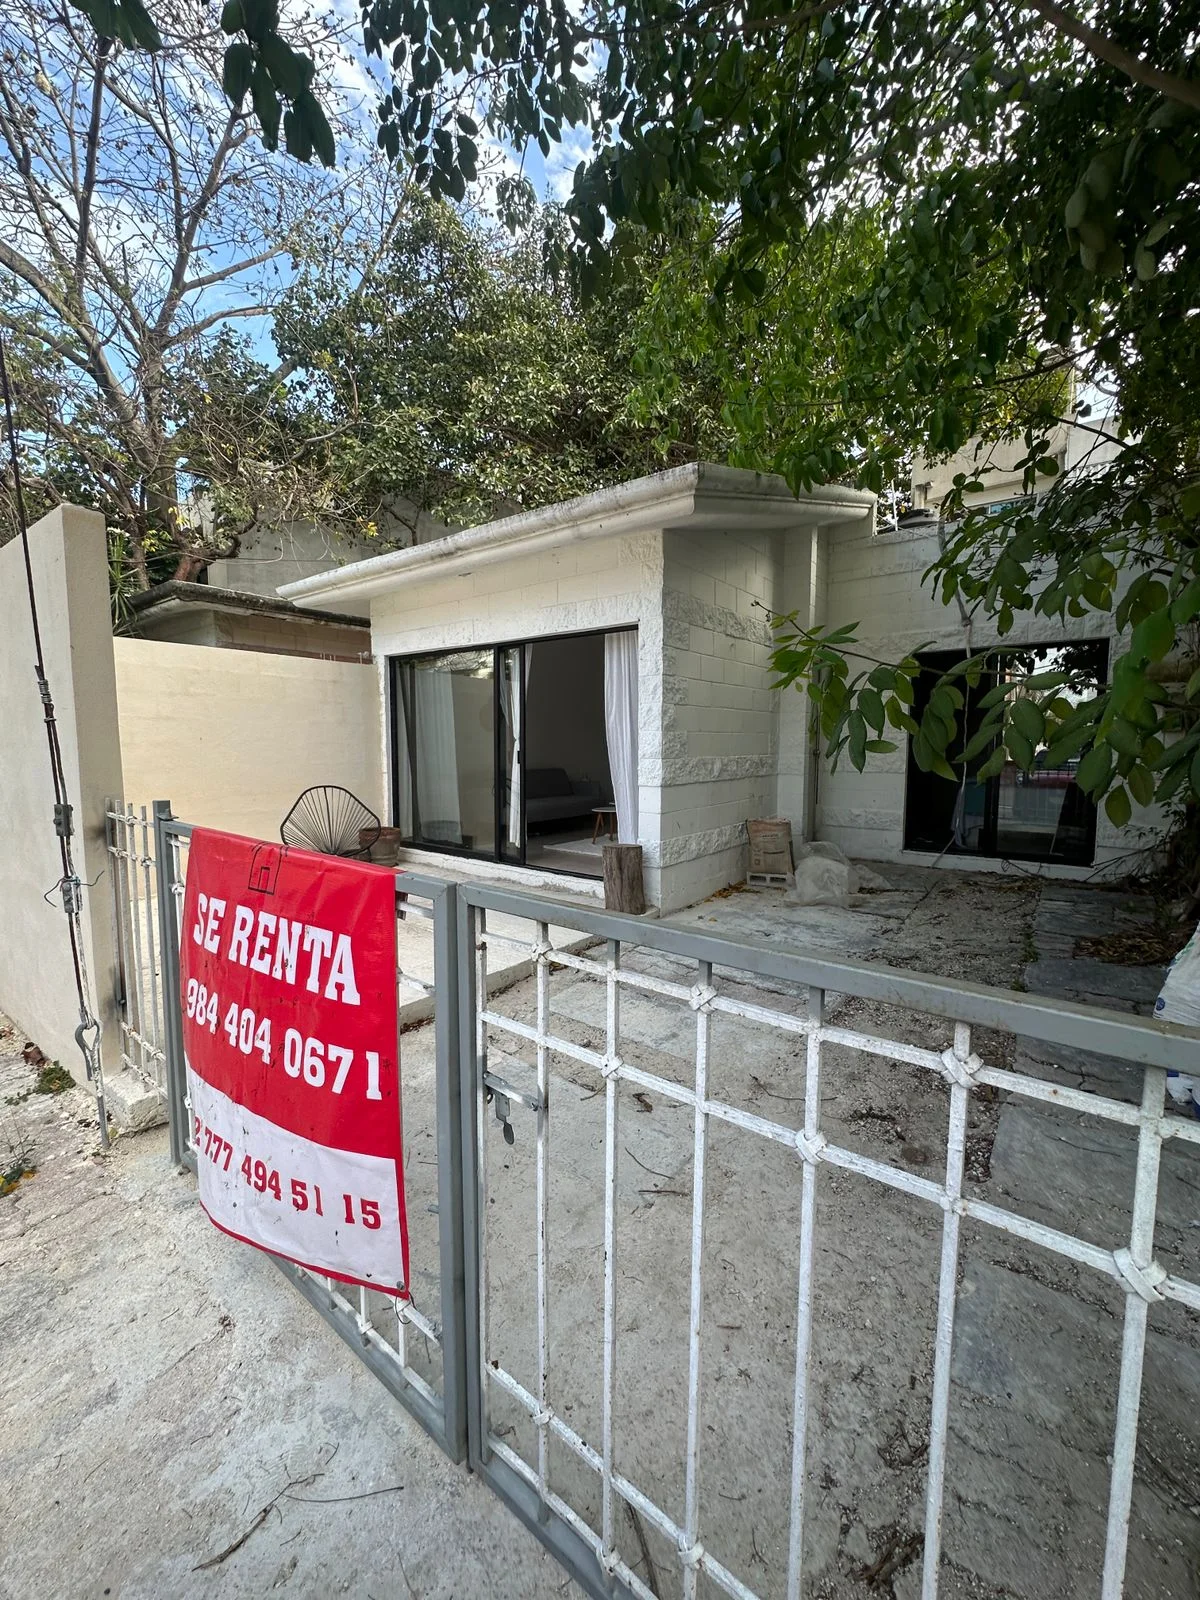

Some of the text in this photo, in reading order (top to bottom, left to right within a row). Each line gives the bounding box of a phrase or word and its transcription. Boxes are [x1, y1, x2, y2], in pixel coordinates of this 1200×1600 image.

[192, 892, 361, 1006] SE RENTA
[186, 978, 218, 1035] 984
[224, 1002, 272, 1065] 404
[204, 1126, 234, 1172] 777
[241, 1154, 282, 1202] 494
[290, 1178, 324, 1217] 51
[342, 1193, 383, 1231] 15
